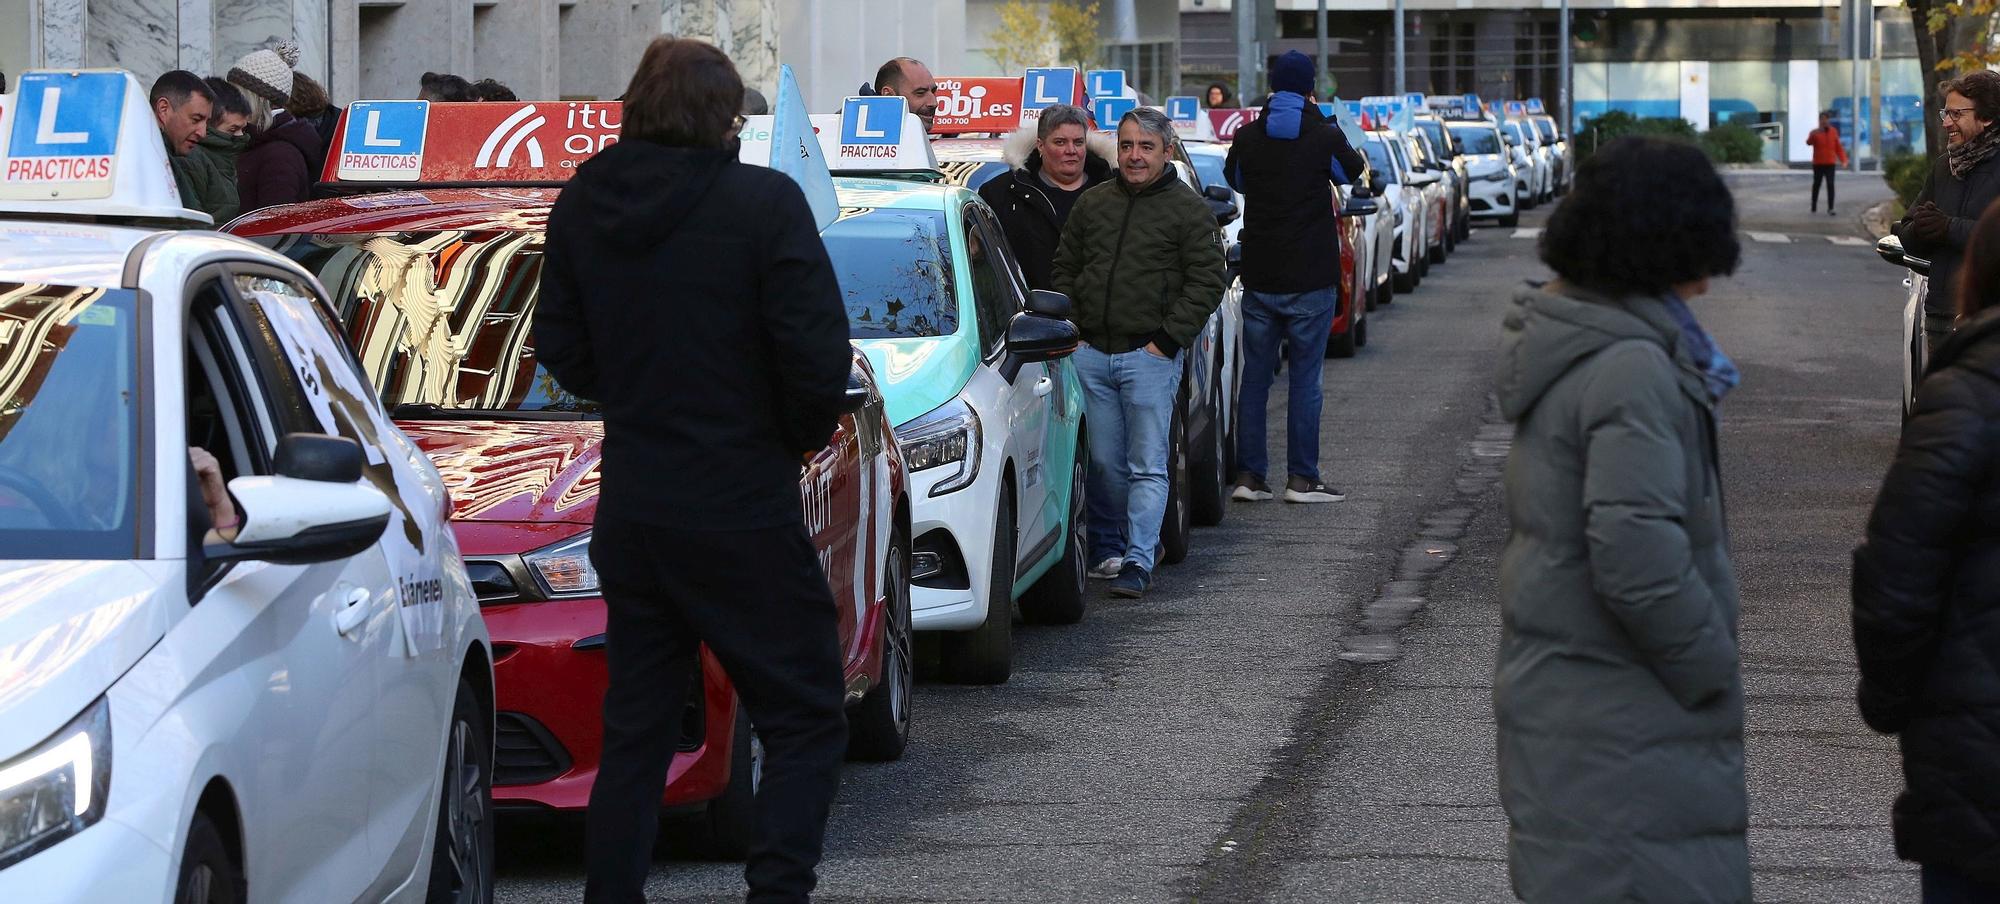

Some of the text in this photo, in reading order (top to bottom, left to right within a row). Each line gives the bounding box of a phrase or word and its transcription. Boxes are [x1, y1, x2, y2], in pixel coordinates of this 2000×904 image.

[936, 80, 961, 90] oto
[1035, 76, 1058, 103] L
[1095, 76, 1113, 95] L
[935, 86, 1013, 118] obi.es
[1174, 101, 1189, 118] L
[36, 87, 89, 144] L
[856, 105, 884, 137] L
[1105, 104, 1120, 125] L
[364, 111, 400, 146] L
[345, 155, 416, 169] PRACTICAS
[841, 146, 896, 157] PRACTICAS
[8, 157, 110, 180] PRACTICAS
